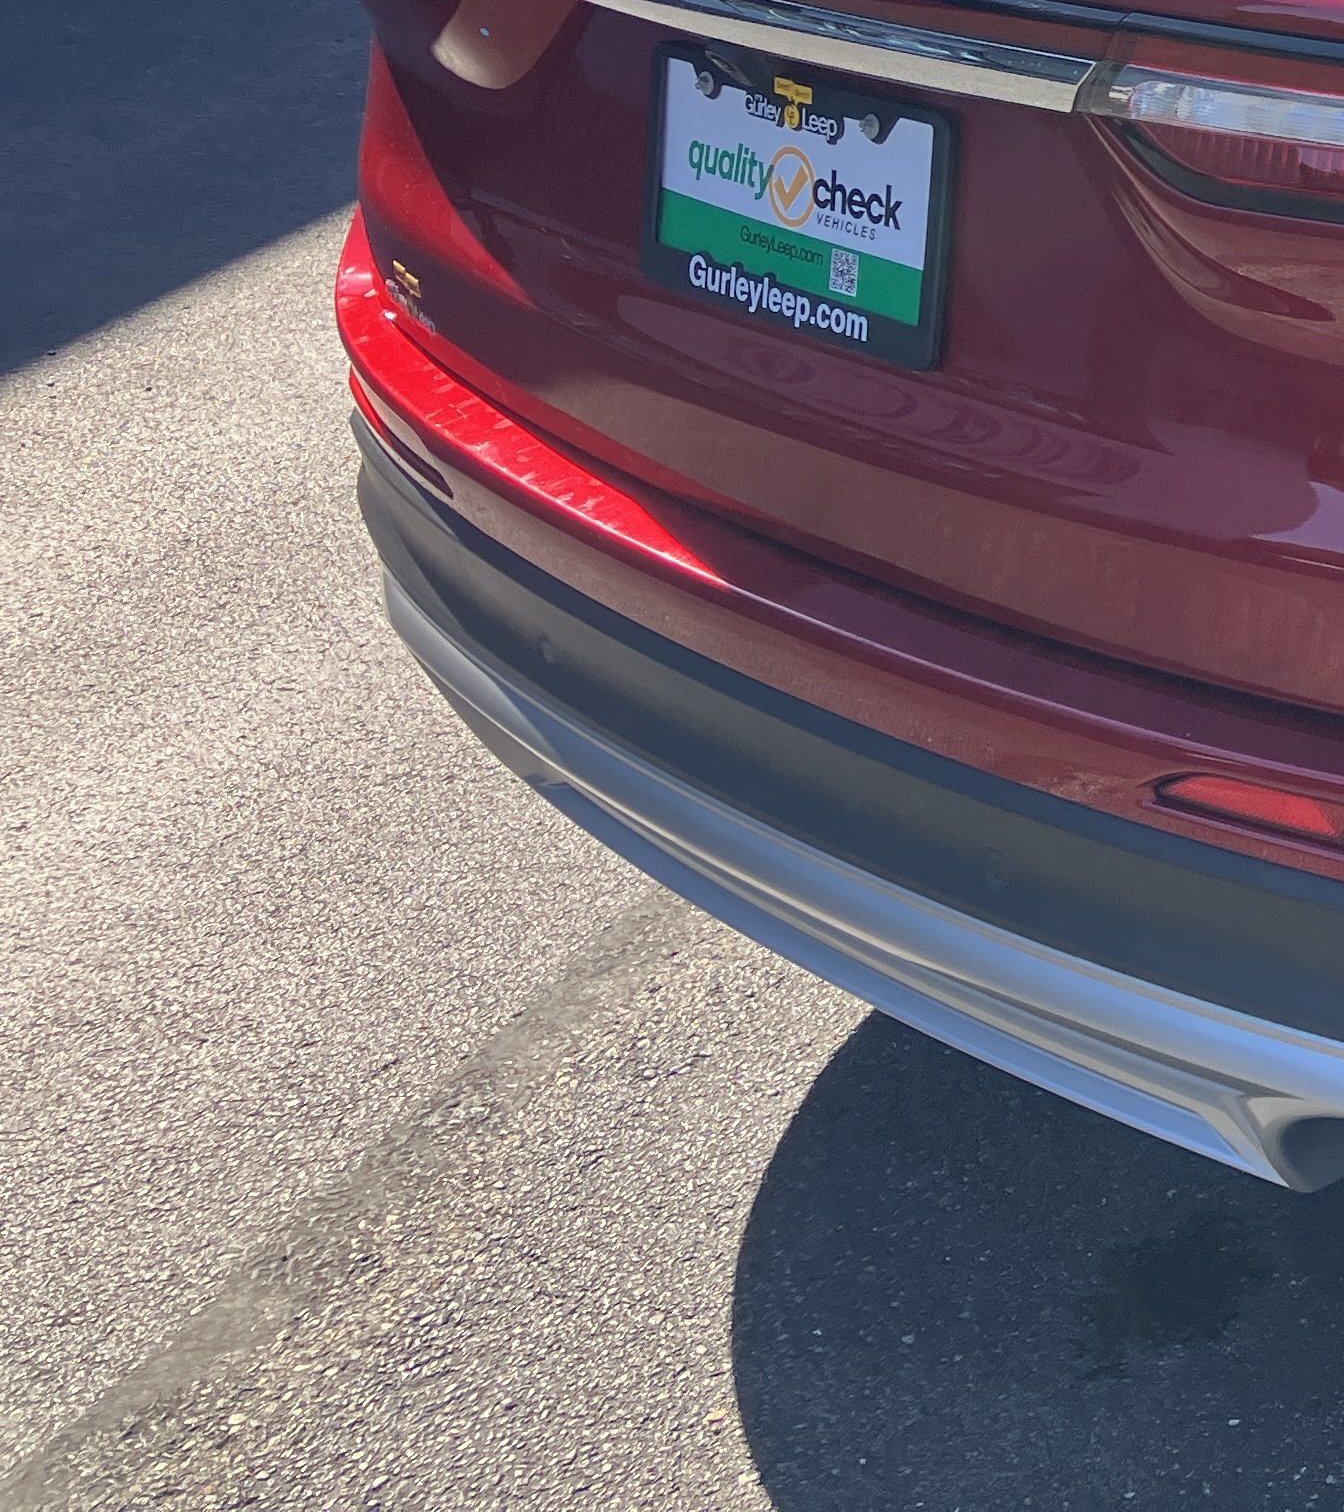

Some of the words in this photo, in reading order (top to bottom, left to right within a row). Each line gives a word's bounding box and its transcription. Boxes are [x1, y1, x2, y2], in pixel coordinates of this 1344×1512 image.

[802, 107, 838, 141] Leep
[688, 139, 774, 200] quality
[812, 169, 902, 230] check
[740, 224, 824, 266] GurleyLeep.com
[816, 212, 877, 241] VEHICLES
[688, 254, 868, 342] Gurleyleep.com
